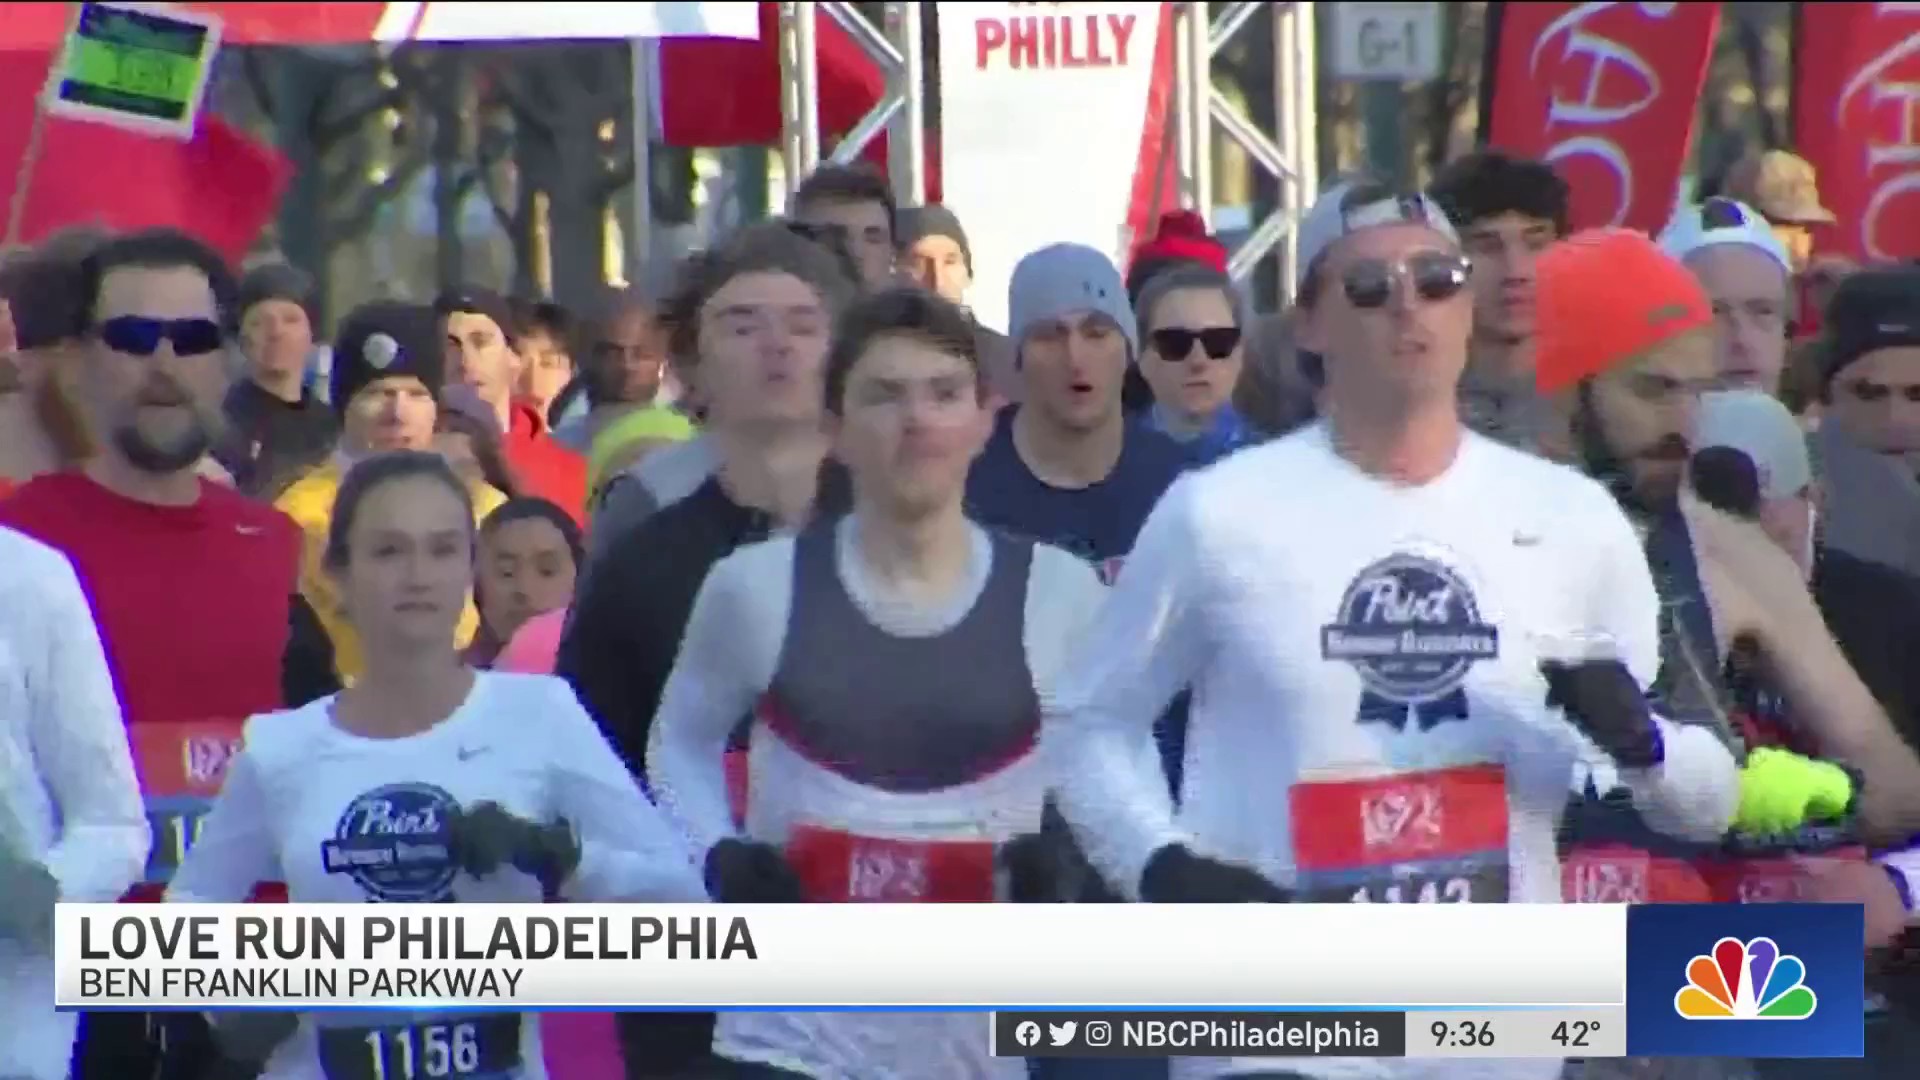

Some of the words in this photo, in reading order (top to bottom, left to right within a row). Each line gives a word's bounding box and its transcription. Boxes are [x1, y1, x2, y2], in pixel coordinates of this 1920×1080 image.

[975, 14, 1136, 70] PHILLY
[1358, 18, 1416, 68] G-1
[364, 1023, 479, 1080] 1156
